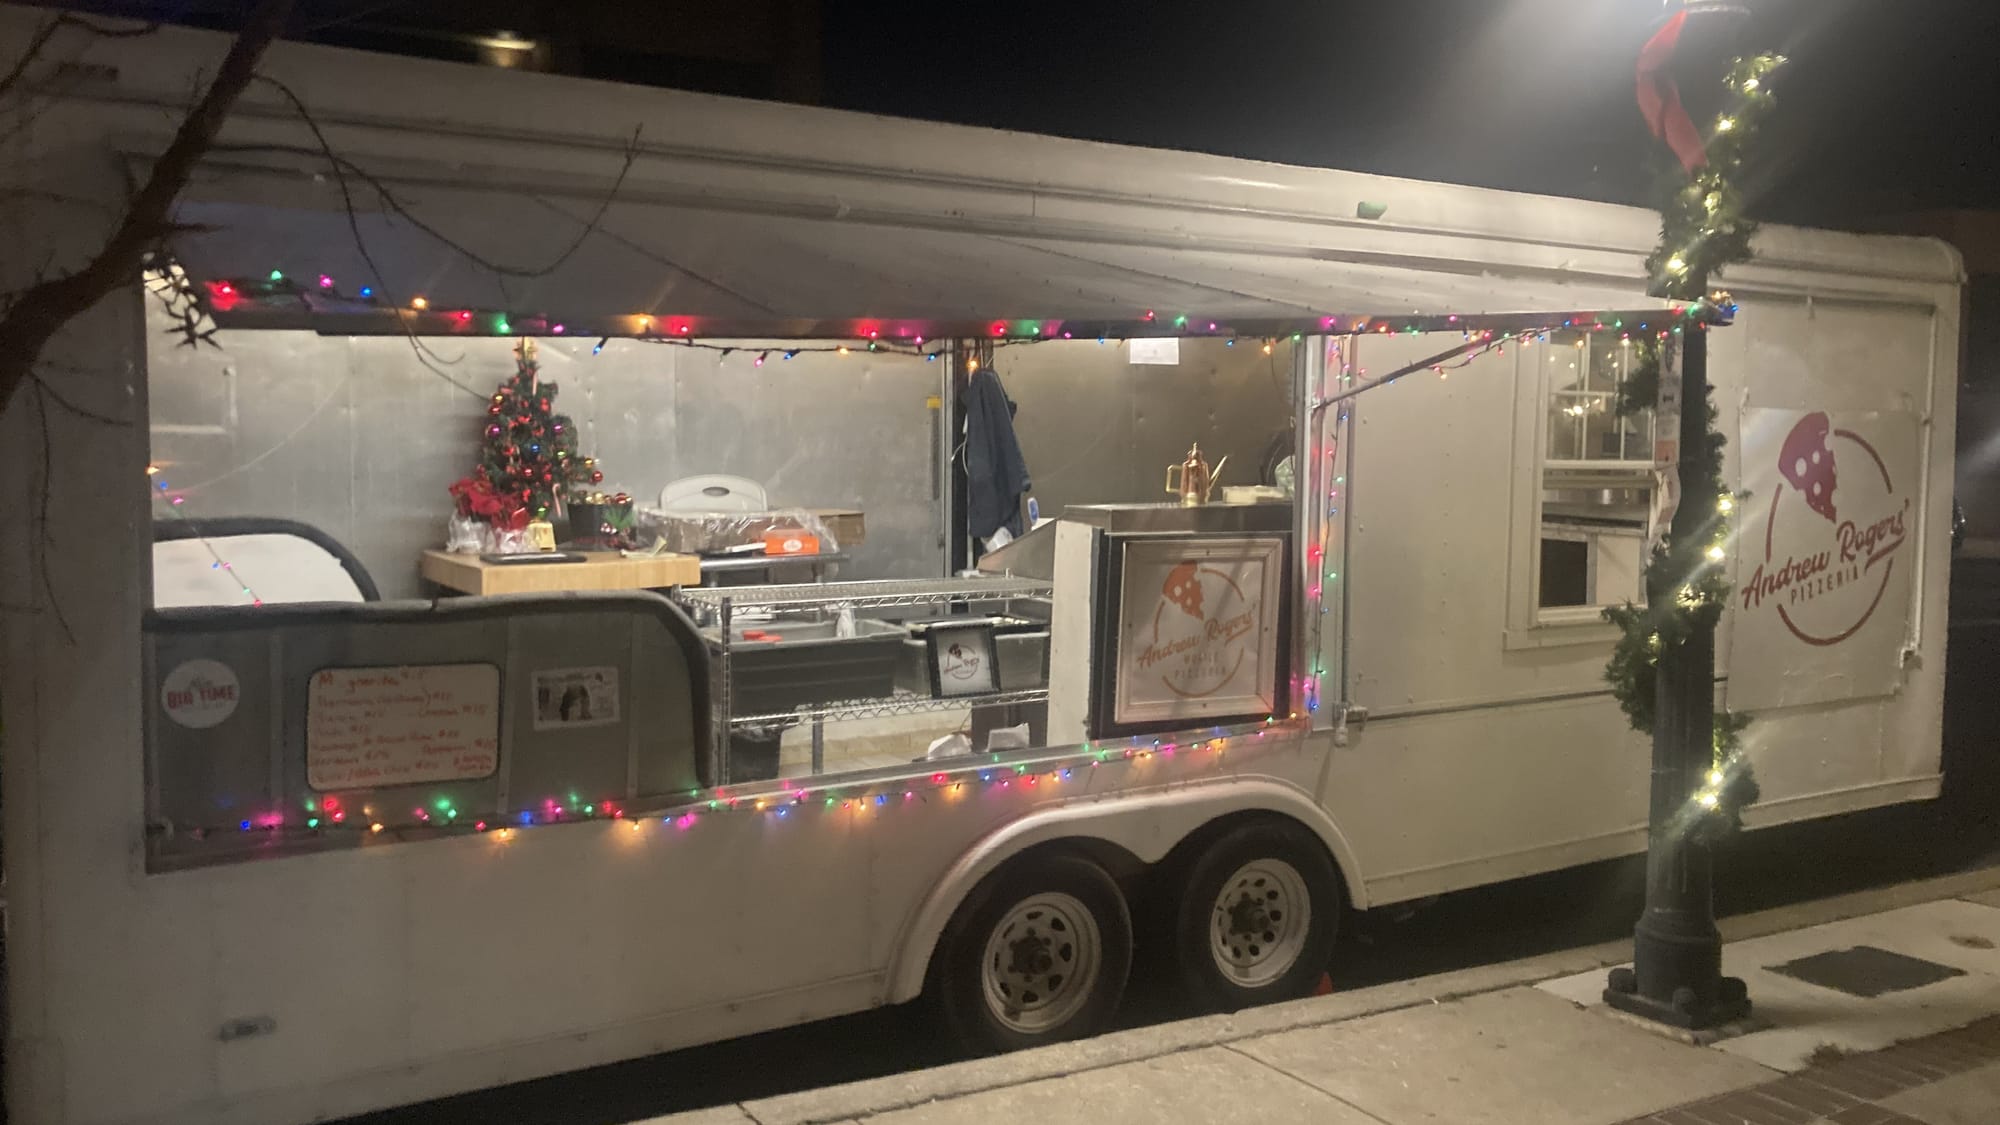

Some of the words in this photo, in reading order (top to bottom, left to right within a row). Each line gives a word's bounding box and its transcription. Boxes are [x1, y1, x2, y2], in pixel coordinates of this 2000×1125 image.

[1741, 551, 1831, 610] Andrew
[1836, 498, 1910, 565] Rogers'
[1790, 565, 1860, 606] PIZZERIA
[1136, 637, 1201, 670] Andrew
[199, 685, 234, 702] TIME
